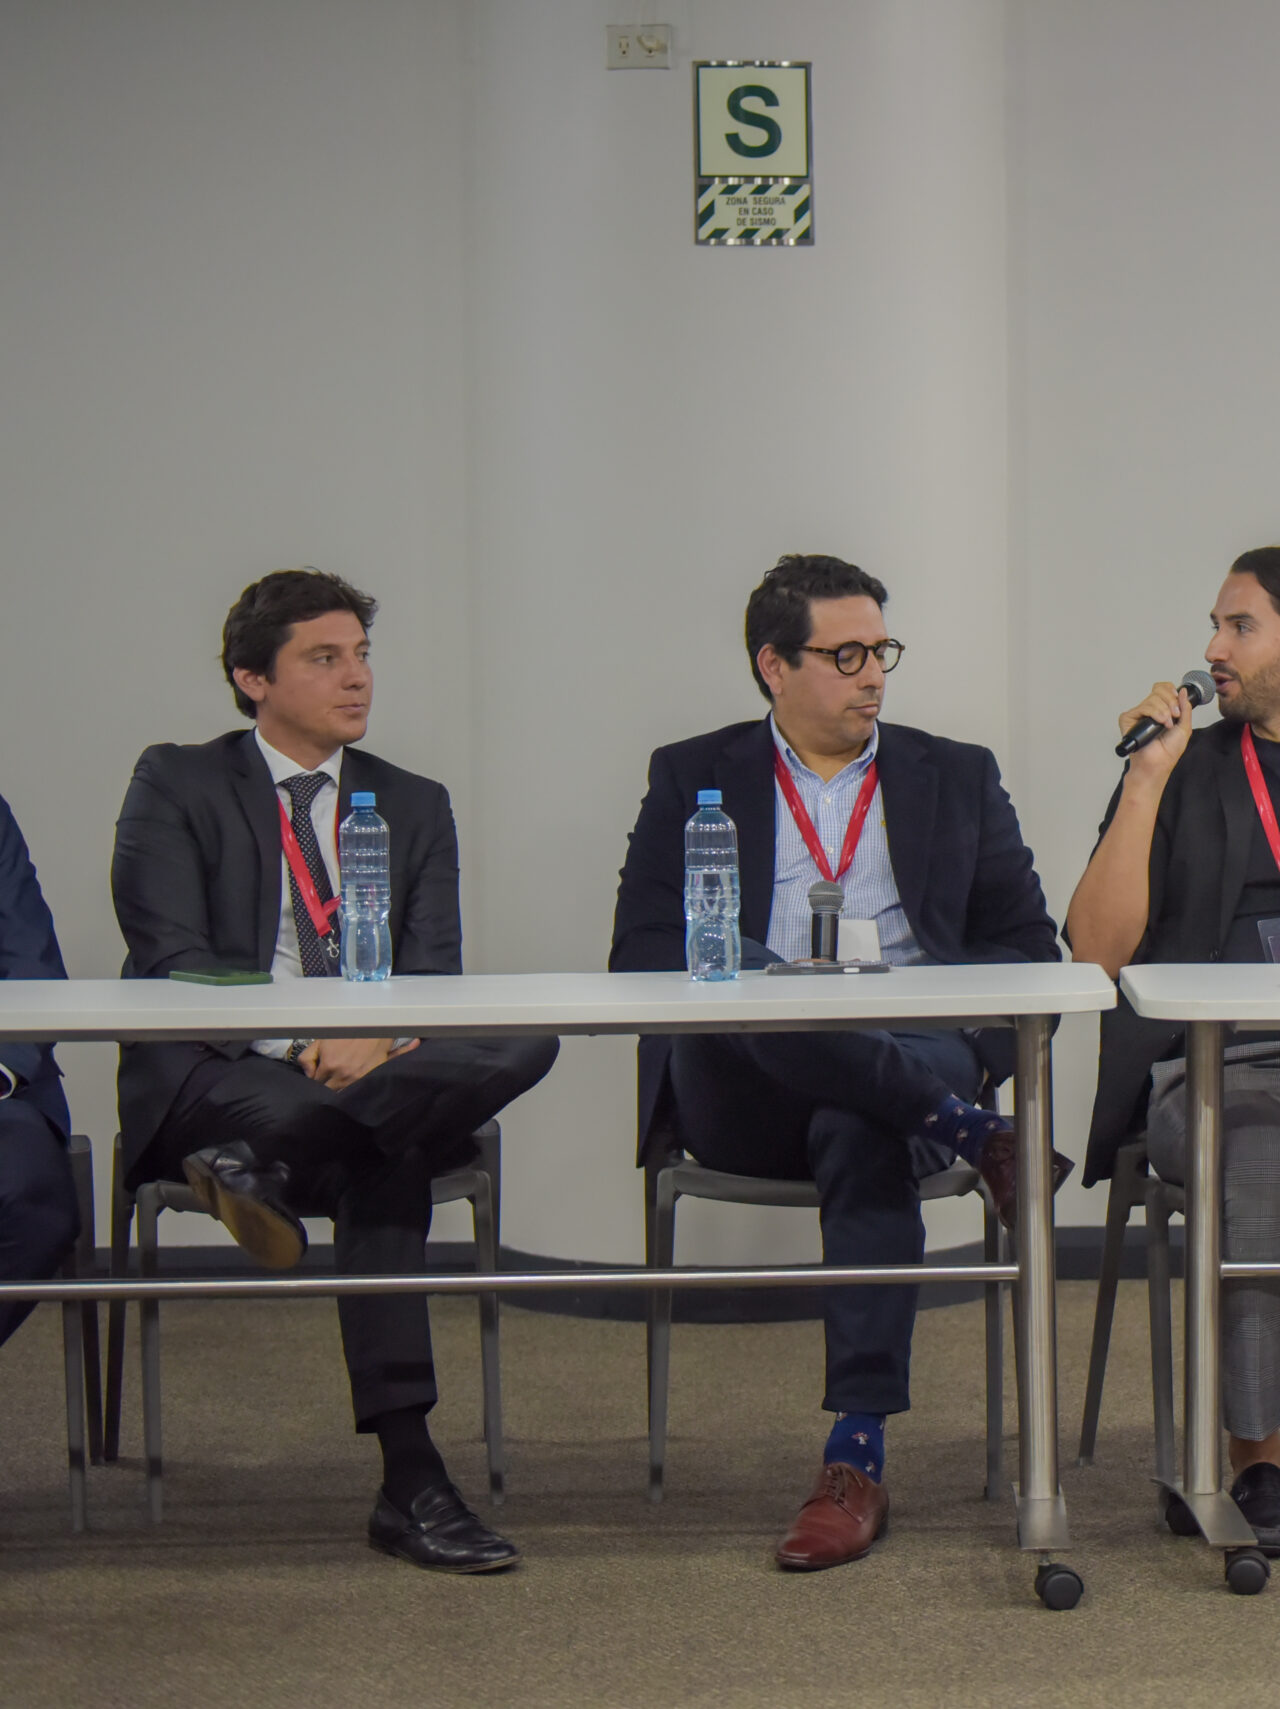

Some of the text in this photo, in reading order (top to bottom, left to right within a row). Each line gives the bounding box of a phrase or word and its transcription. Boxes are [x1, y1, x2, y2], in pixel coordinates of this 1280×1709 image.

[725, 84, 782, 158] S
[726, 197, 786, 205] ZONA SEGURA
[738, 207, 774, 216] EN CASO
[736, 217, 777, 226] DE SISMO
